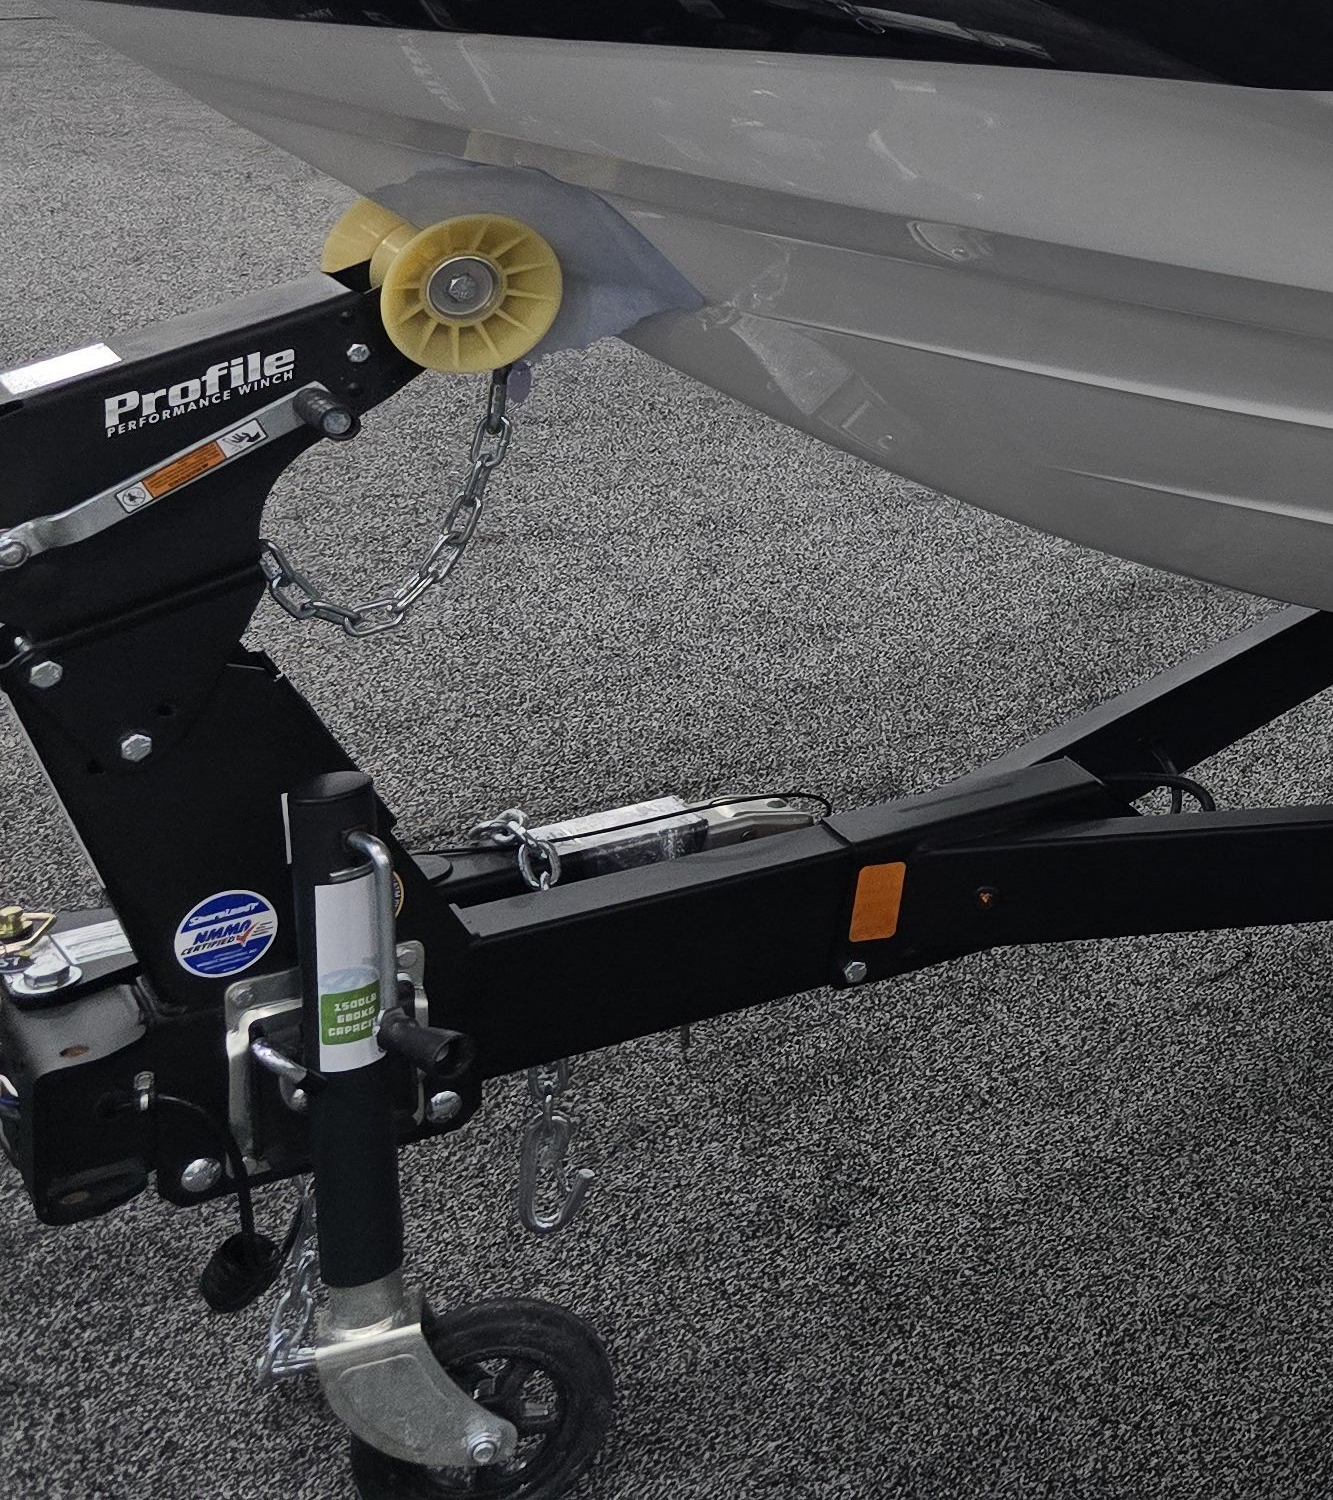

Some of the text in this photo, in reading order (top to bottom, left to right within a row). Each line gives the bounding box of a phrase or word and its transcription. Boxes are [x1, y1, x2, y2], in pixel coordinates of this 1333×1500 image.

[104, 348, 295, 429] Profile
[106, 369, 294, 438] PERFORMANCE WINCH
[180, 936, 235, 956] CERTIFIED
[333, 992, 378, 1013] 1500LB
[327, 1017, 378, 1037] CAPACIT
